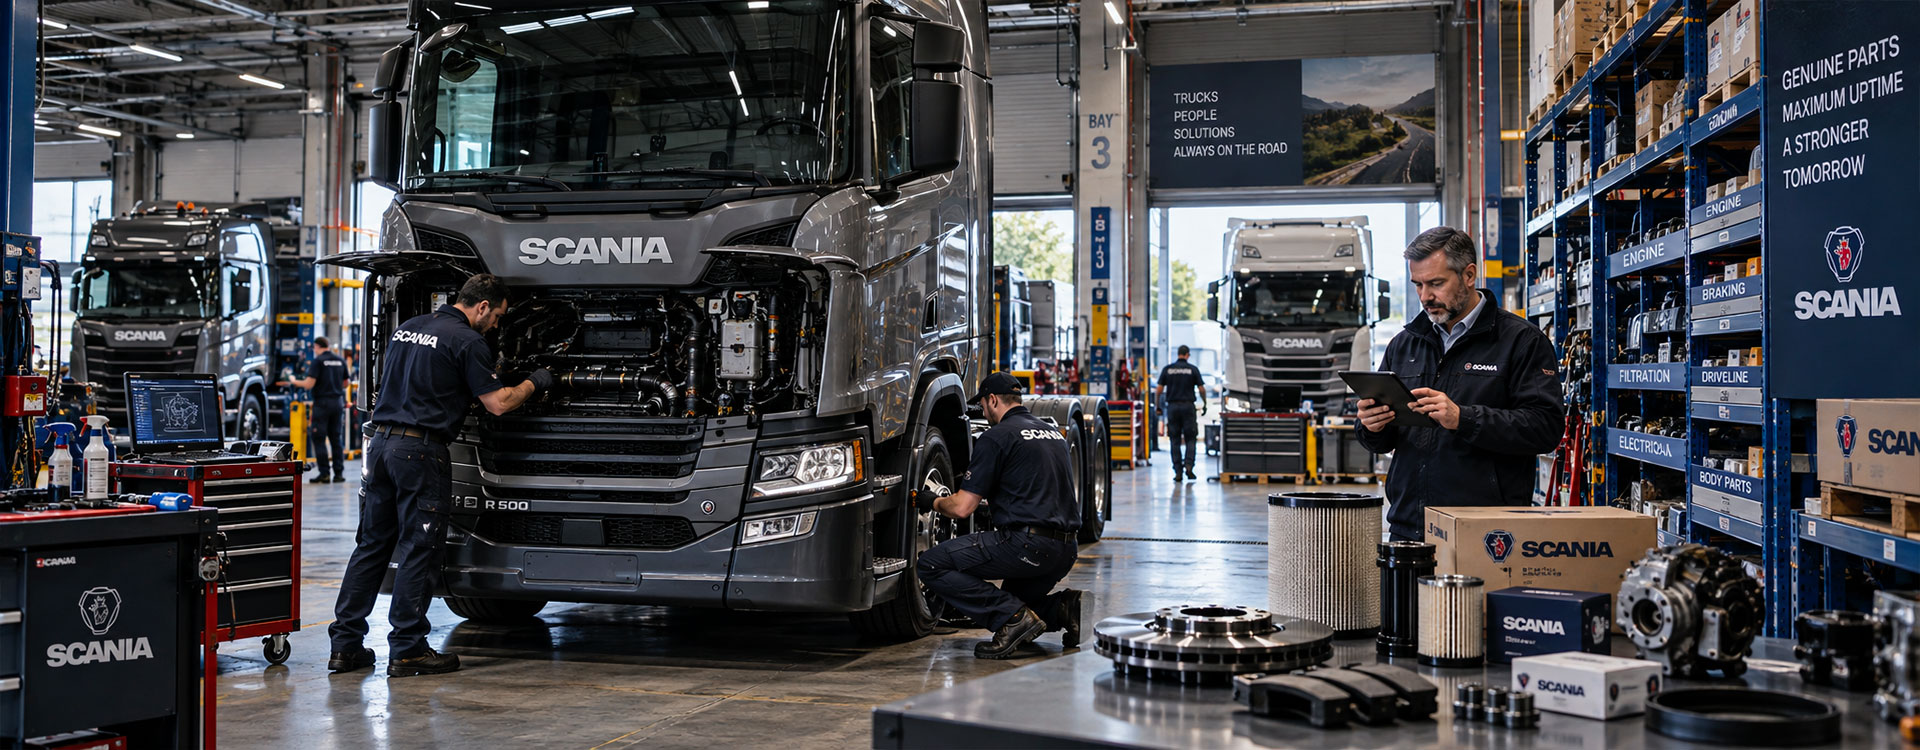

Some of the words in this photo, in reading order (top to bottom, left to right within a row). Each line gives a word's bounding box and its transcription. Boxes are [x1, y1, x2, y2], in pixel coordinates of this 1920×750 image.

[1782, 52, 1844, 91] GENUINE
[1848, 35, 1900, 71] PARTS
[1173, 91, 1219, 104] TRUCKS
[1782, 87, 1846, 123] MAXIMUM
[1849, 70, 1904, 105] UPTIME
[1089, 113, 1113, 129] BAY
[1174, 109, 1217, 122] PEOPLE
[1174, 126, 1236, 140] SOLUTIONS
[1783, 137, 1792, 157] A
[1795, 118, 1869, 154] STRONGER
[1091, 136, 1111, 169] 3
[1173, 145, 1215, 158] ALWAYS
[1217, 144, 1233, 156] ON
[1235, 143, 1256, 155] THE
[1258, 142, 1288, 155] ROAD
[1783, 153, 1865, 189] TOMORROW
[1705, 194, 1742, 218] ENGINE
[518, 236, 673, 265] SCANIA
[1623, 242, 1665, 268] ENGINE
[1702, 282, 1746, 301] BRAKING
[1794, 286, 1902, 320] SCANIA
[114, 330, 167, 341] SCANIA
[392, 329, 438, 348] SCANIA
[1272, 338, 1323, 348] SCANIA
[1619, 369, 1671, 383] FILTRATION
[1702, 370, 1749, 383] DRIVELINE
[1700, 471, 1722, 487] BODY
[1724, 475, 1752, 494] PARTS
[485, 500, 495, 510] R
[498, 500, 528, 511] 500
[1521, 540, 1614, 558] SCANIA
[1503, 616, 1566, 636] SCANIA
[47, 637, 154, 668] SCANIA
[1538, 679, 1585, 697] SCANIA
